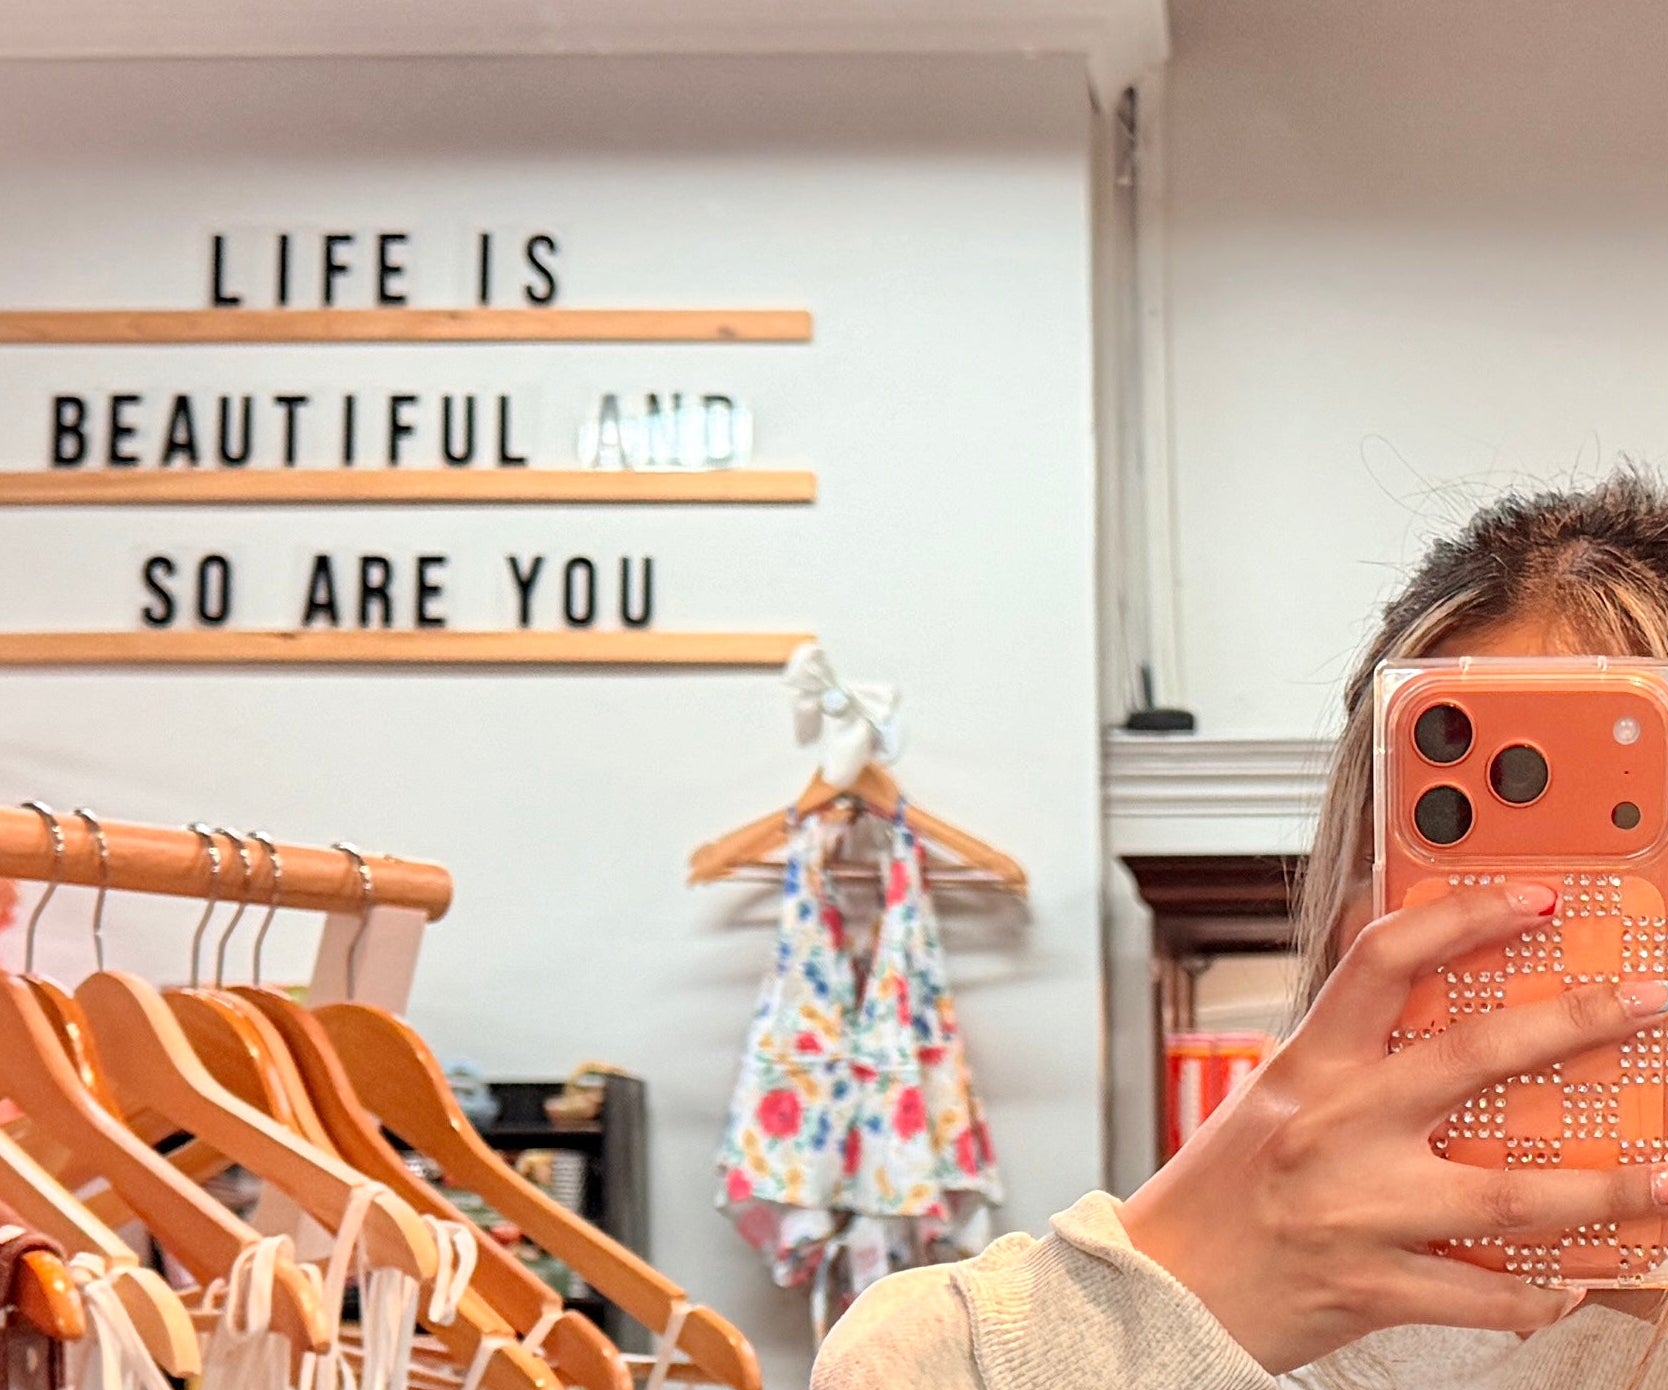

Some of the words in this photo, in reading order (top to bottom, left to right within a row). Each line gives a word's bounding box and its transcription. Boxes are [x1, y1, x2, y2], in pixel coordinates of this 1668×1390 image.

[212, 234, 410, 308] LIFE
[480, 233, 561, 308] IS
[52, 394, 528, 468] BEAUTIFUL
[142, 555, 232, 628] SO
[303, 556, 447, 628] ARE
[509, 556, 656, 628] YOU
